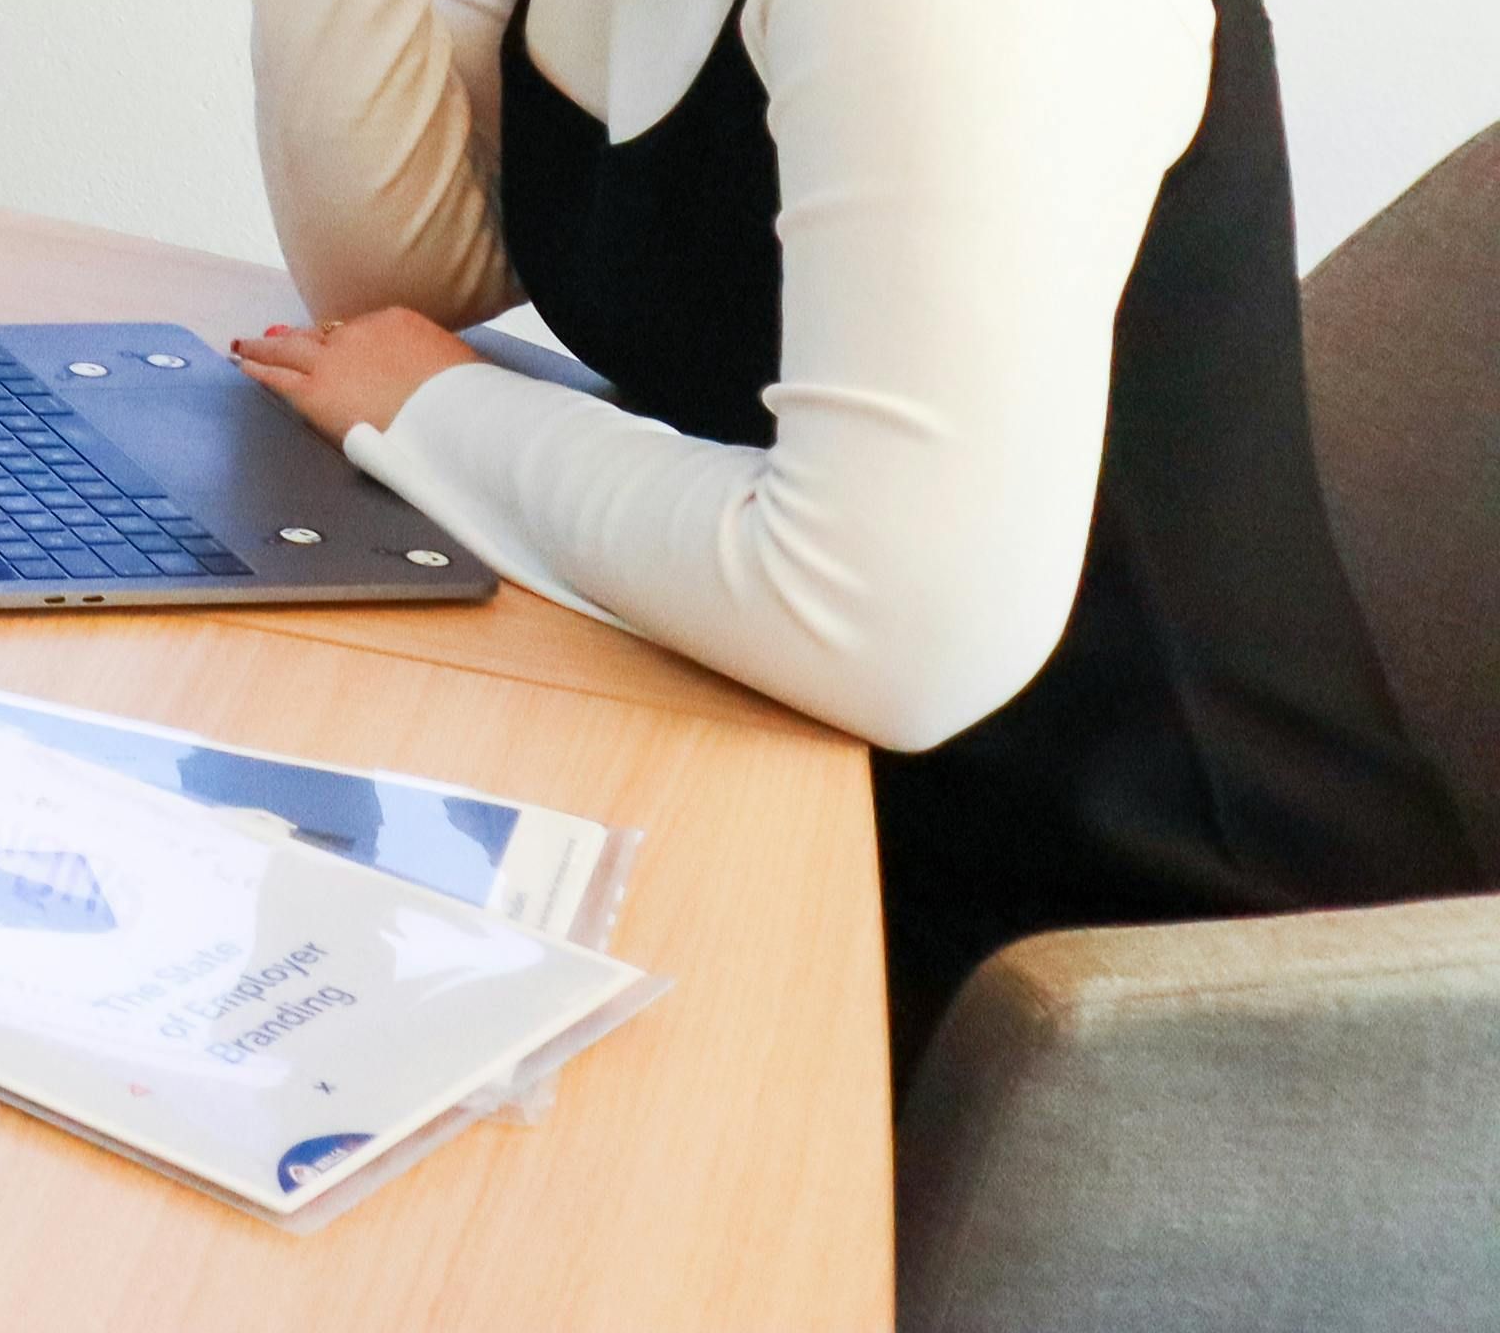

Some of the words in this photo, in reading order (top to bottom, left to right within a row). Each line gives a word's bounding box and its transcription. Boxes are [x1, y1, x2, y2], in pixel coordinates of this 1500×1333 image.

[92, 982, 168, 1014] The
[154, 940, 243, 985] State
[159, 1012, 198, 1040] of
[185, 941, 330, 1022] Employer
[204, 984, 358, 1065] Branding
